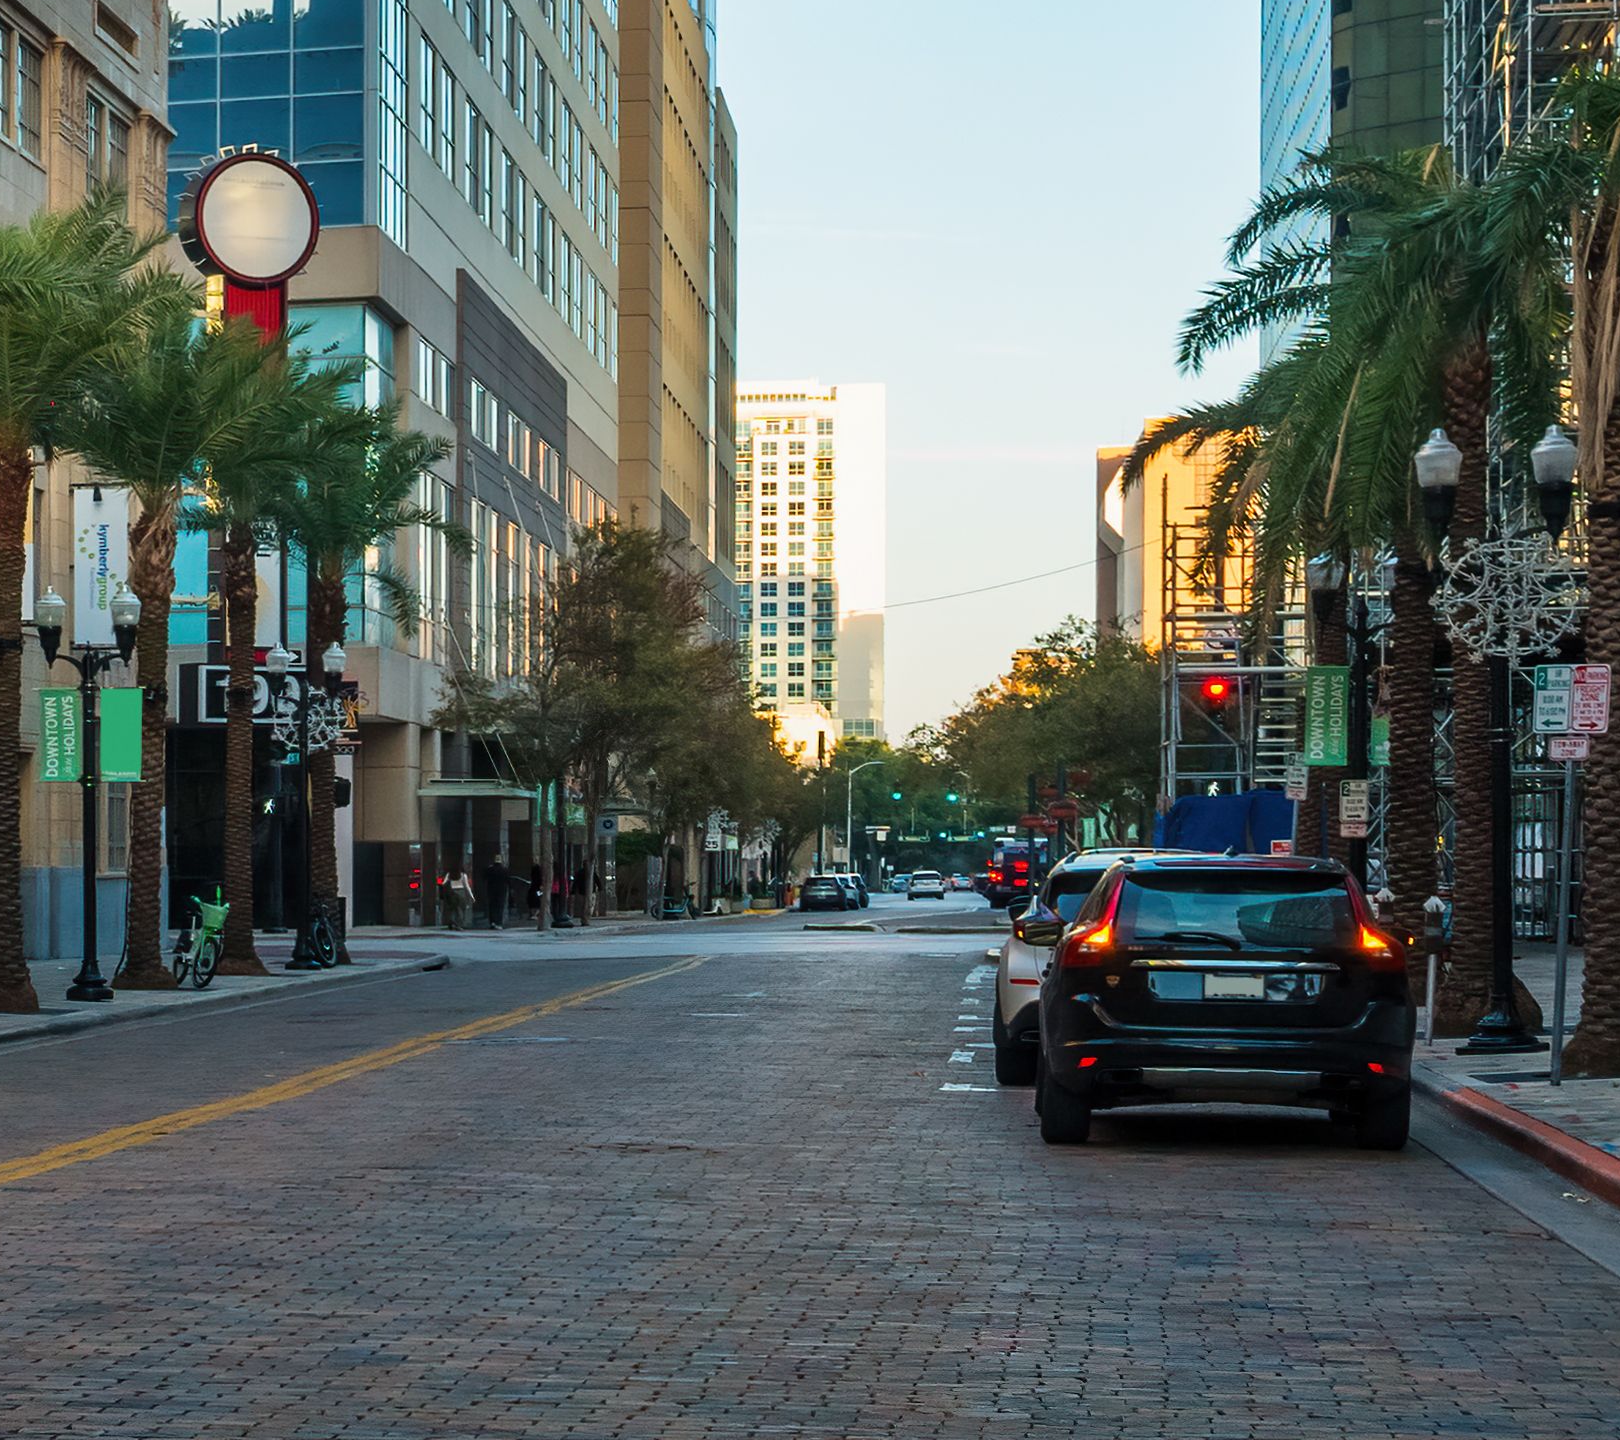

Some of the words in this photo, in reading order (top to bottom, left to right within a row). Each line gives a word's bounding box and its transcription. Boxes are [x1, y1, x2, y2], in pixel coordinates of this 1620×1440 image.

[1329, 675, 1344, 737] HOLIDAYS
[1538, 671, 1546, 686] 2
[44, 696, 59, 778] DOWNTOWN
[61, 694, 75, 756] HOLIDAYS
[1310, 675, 1326, 760] DOWNTOWN
